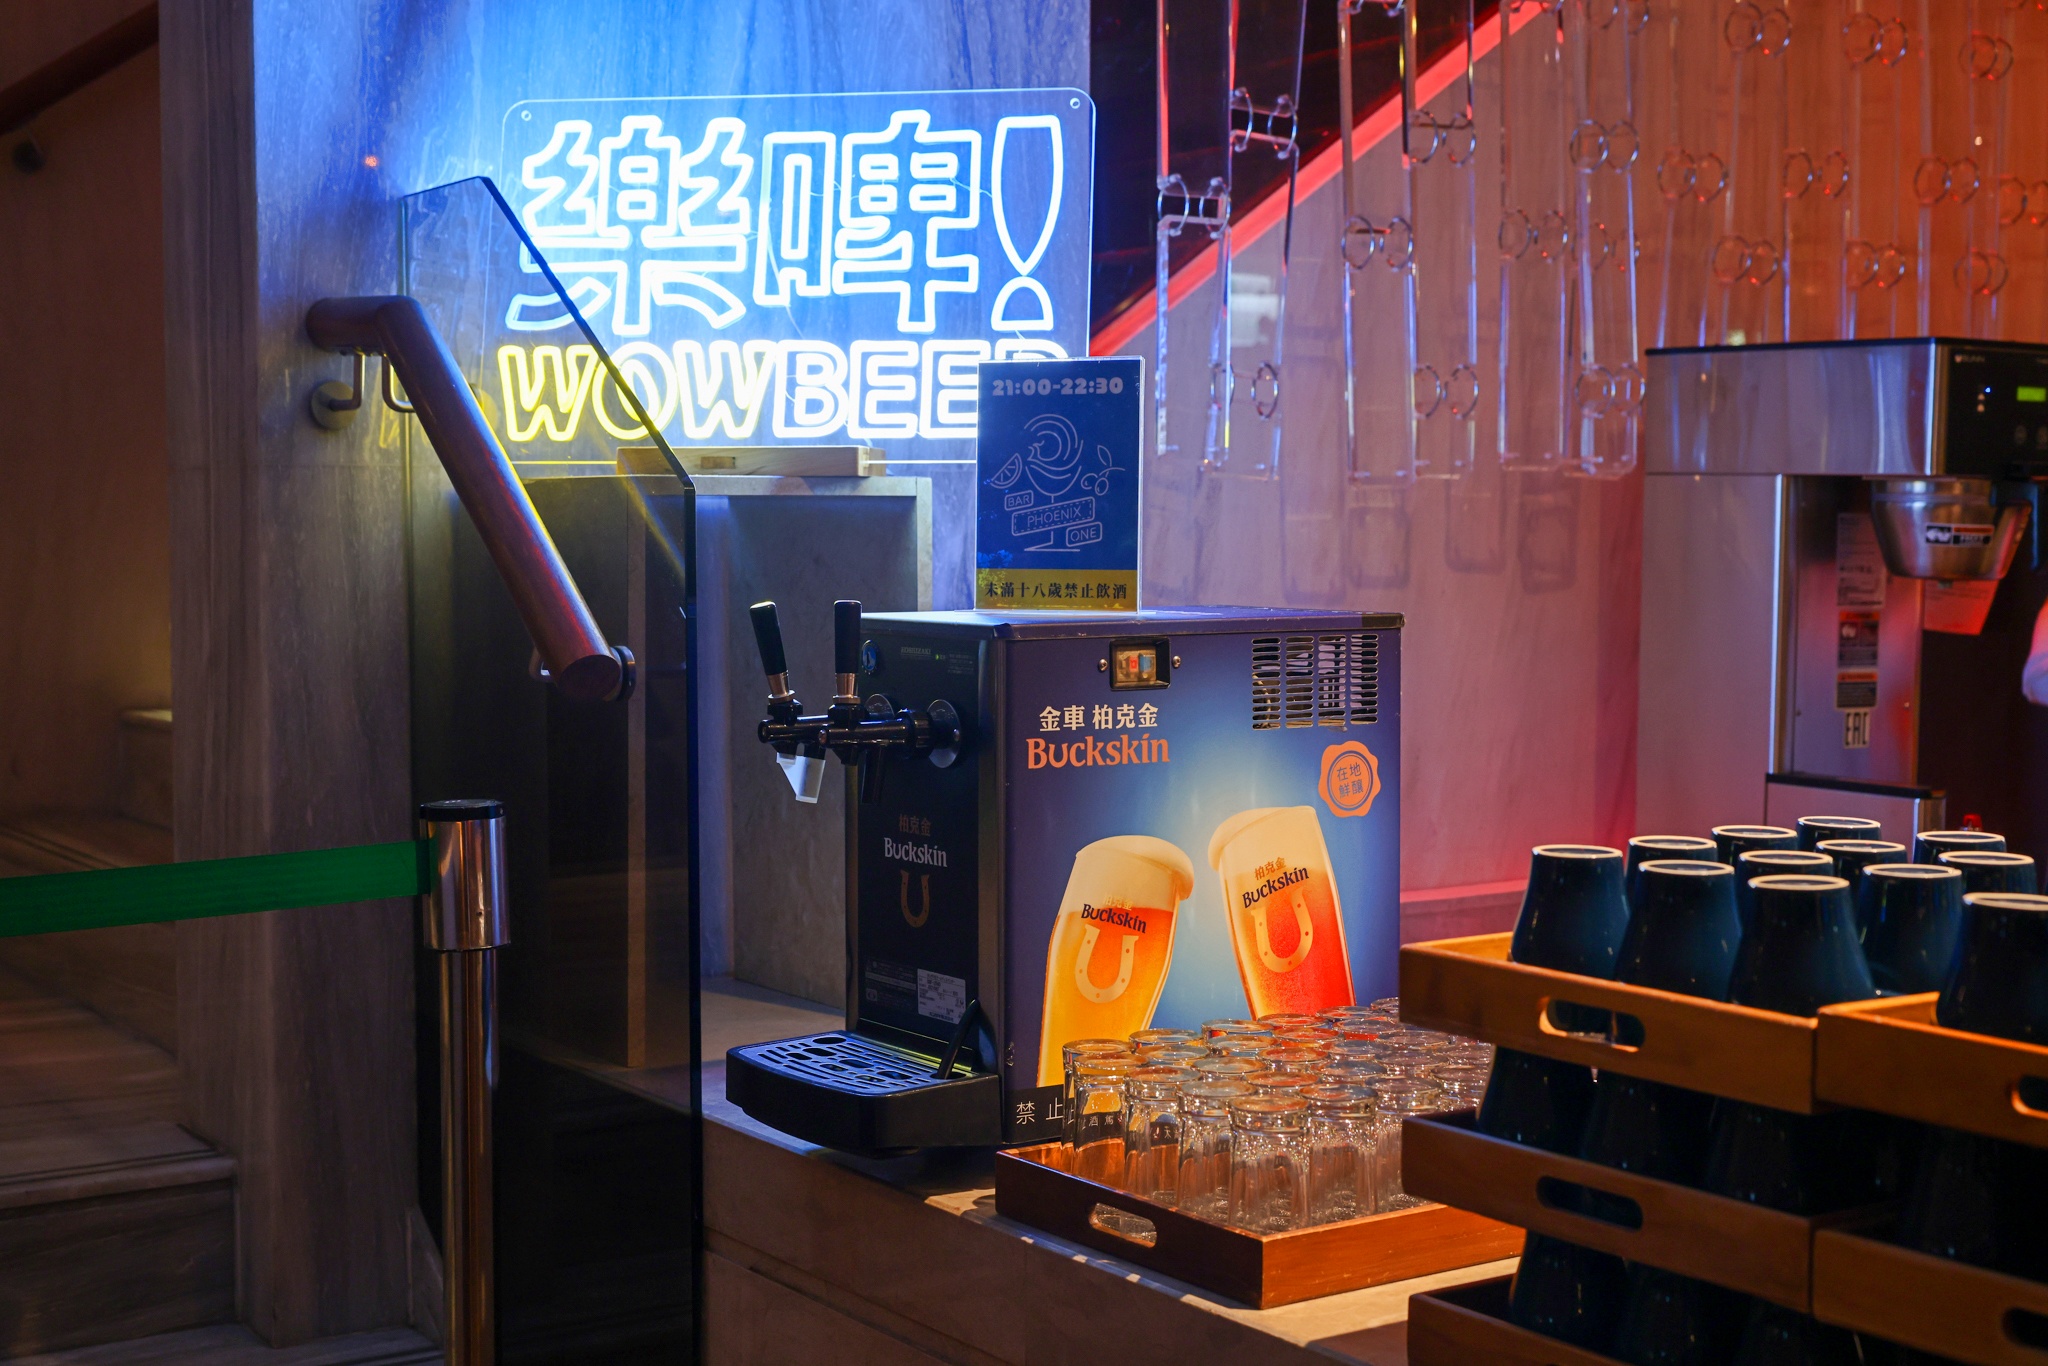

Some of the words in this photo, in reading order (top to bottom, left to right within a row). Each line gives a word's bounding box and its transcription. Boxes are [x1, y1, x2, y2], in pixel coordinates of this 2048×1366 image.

[497, 338, 1069, 443] WOWBEE
[992, 376, 1124, 396] 21:00-22:30
[1007, 494, 1030, 507] BAR
[1027, 505, 1081, 528] PHOENIX
[1070, 526, 1097, 542] ONE
[985, 581, 1127, 600] 未滿十八歲禁止飲酒
[1039, 705, 1085, 732] 金車
[1092, 702, 1159, 730] 柏克金
[1026, 733, 1170, 769] Buckskin
[1336, 762, 1362, 782] 在地
[899, 814, 931, 837] 柏克金
[883, 837, 947, 868] Buckskin
[1254, 856, 1287, 881] 柏克金
[1242, 867, 1310, 909] Buckskin
[1081, 903, 1147, 934] Buckskin
